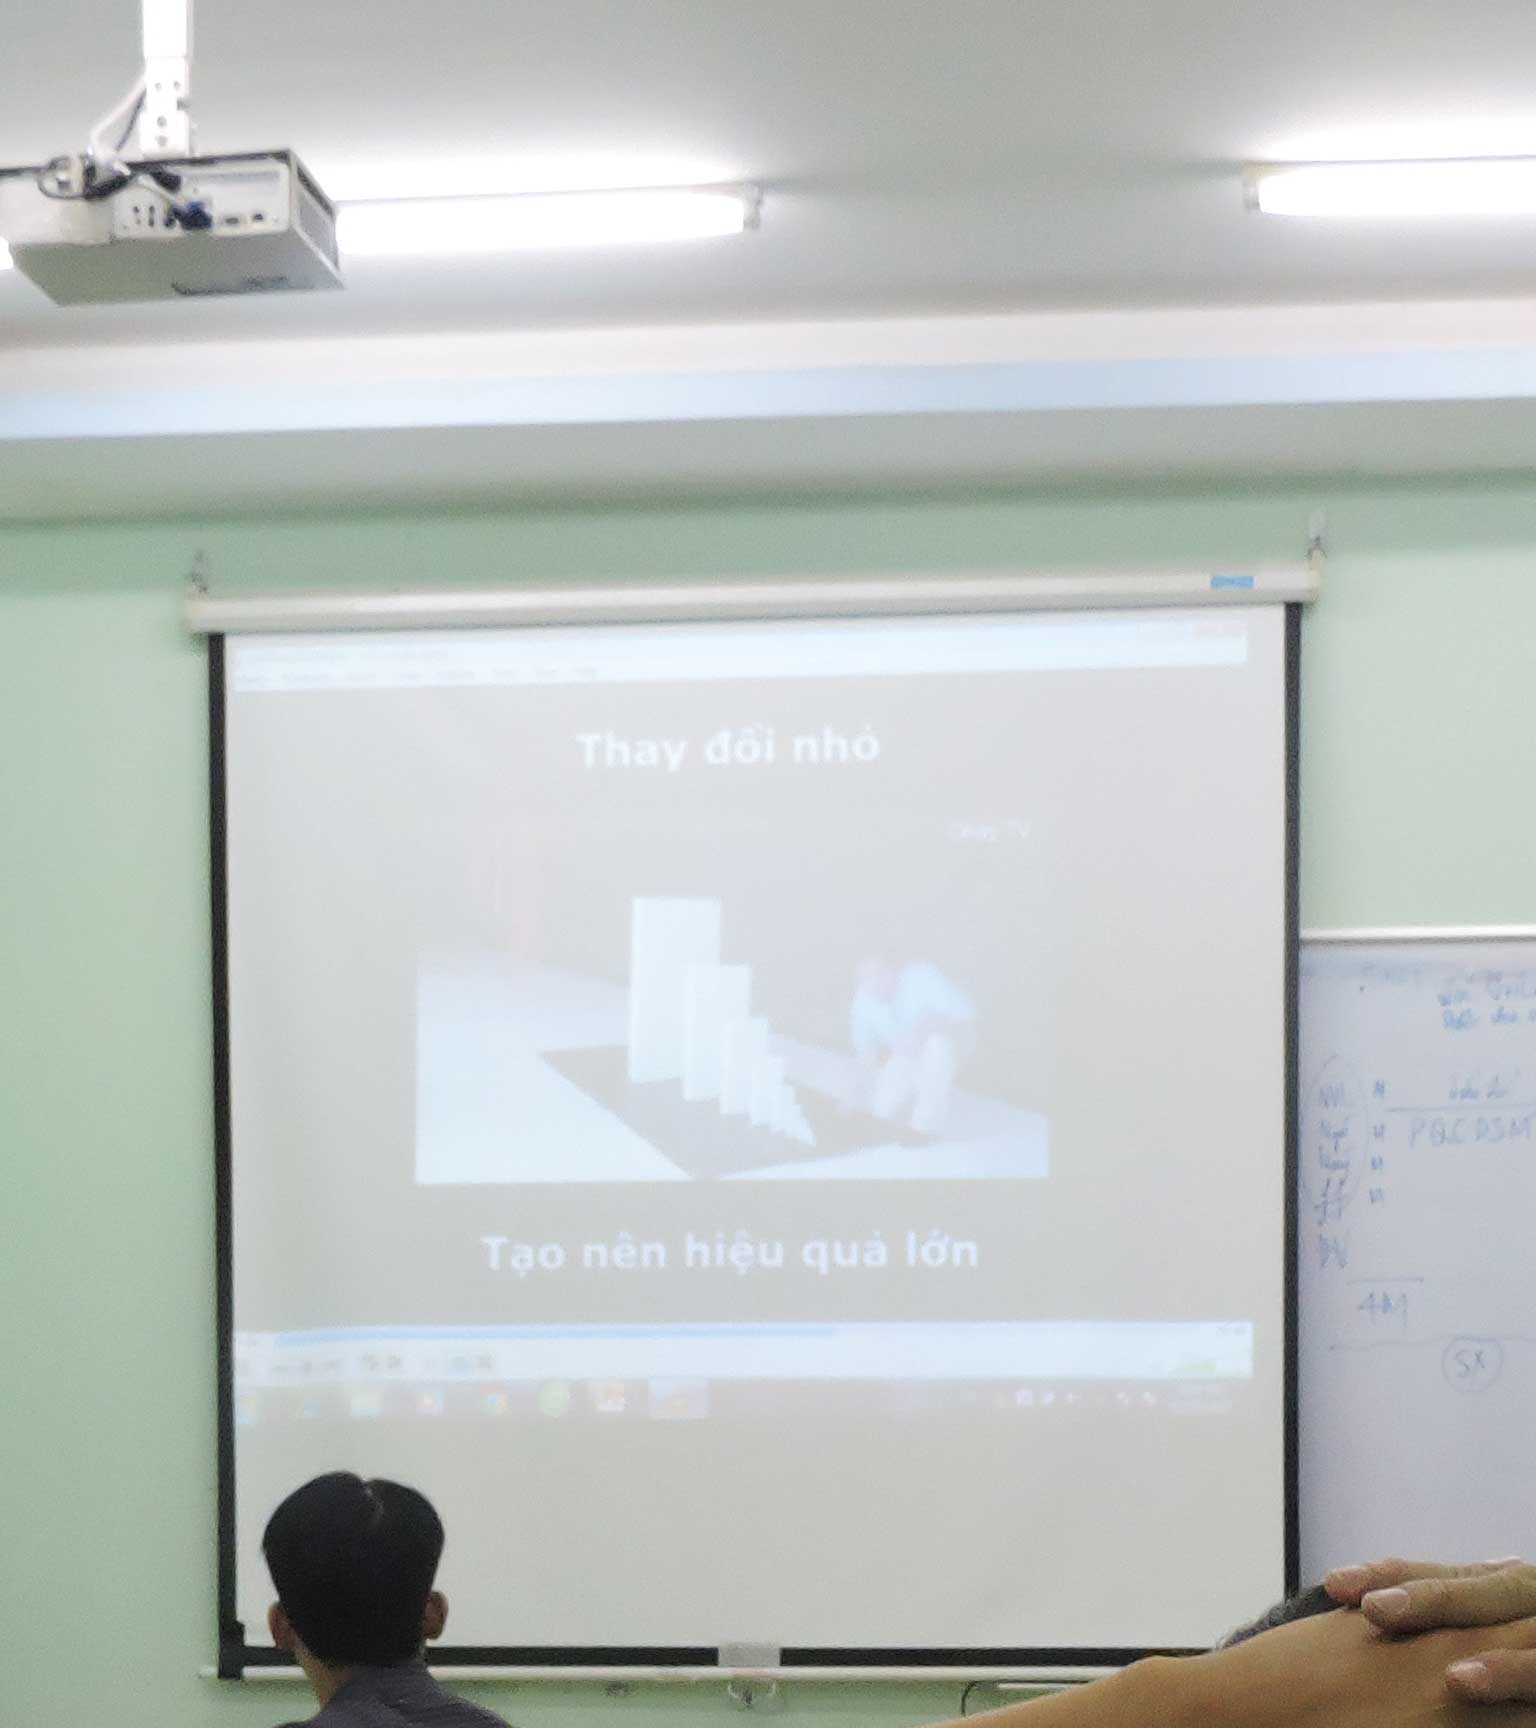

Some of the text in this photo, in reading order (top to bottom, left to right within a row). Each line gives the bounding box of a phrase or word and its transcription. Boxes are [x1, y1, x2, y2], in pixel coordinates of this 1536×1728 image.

[576, 732, 687, 773] Thay
[792, 722, 880, 766] nhỏ
[480, 1230, 980, 1279] Tạo nên hiệu quả lớn
